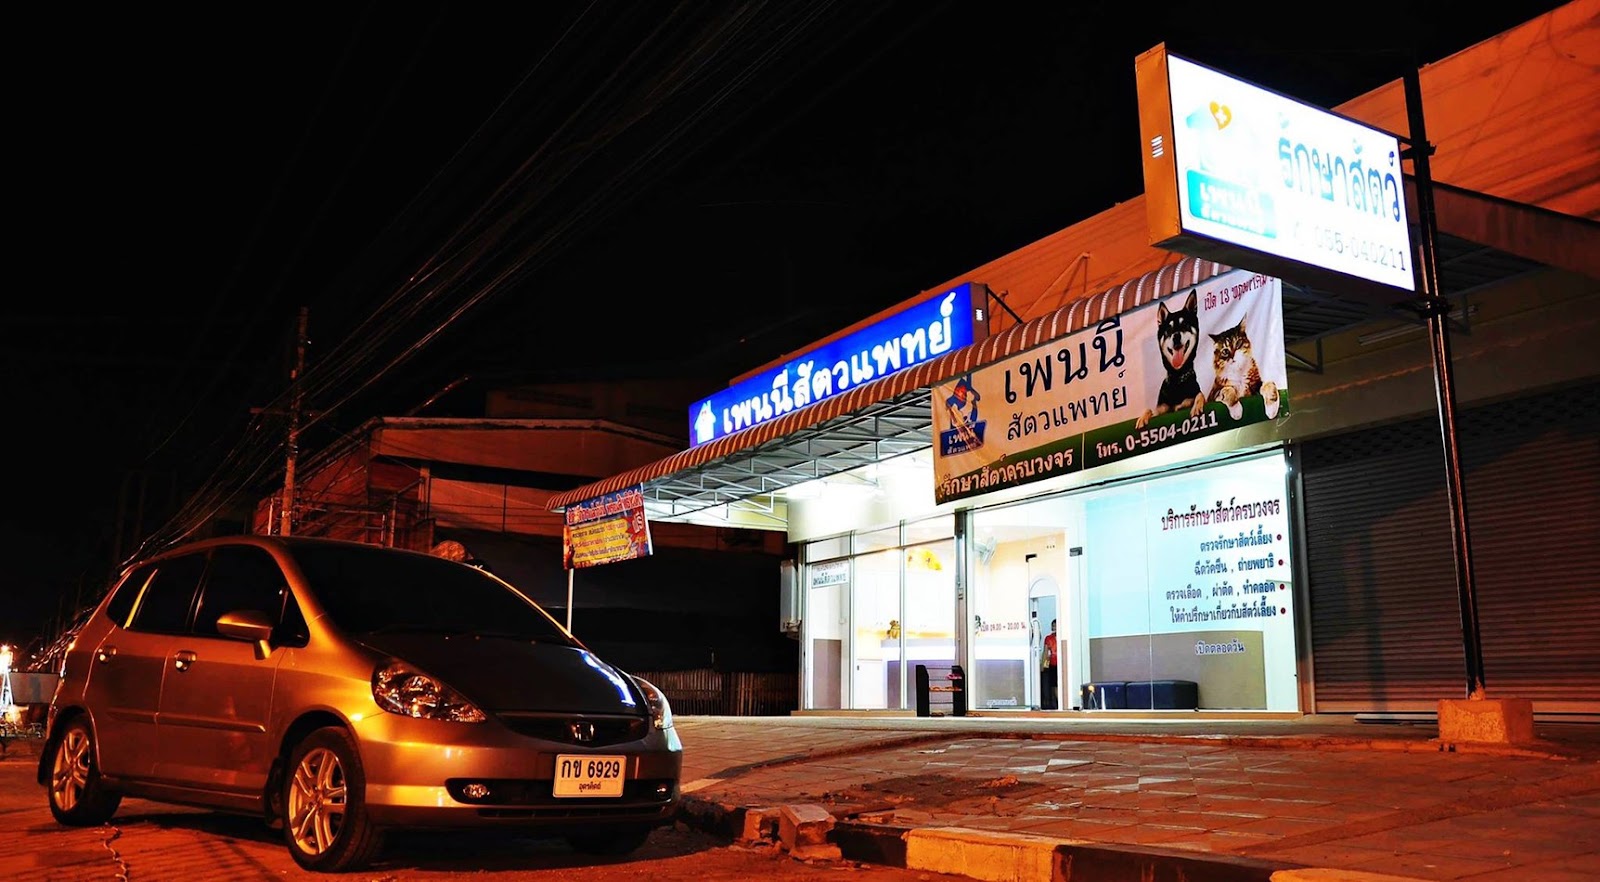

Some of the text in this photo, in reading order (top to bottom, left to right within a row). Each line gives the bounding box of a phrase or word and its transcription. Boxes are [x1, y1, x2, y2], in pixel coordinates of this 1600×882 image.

[1278, 112, 1400, 222] รักษาสัตว์
[1204, 292, 1217, 311] เปิด
[1220, 288, 1230, 305] 13
[723, 292, 956, 433] เพนนีสัตวแพทย์
[1005, 315, 1125, 404] เพนนี
[1007, 370, 1127, 441] สัตวแพทย์
[1096, 410, 1218, 459] โทร. 0-5504-0211
[942, 454, 1074, 496] รักษาสัตว์ครบวงจร
[1161, 497, 1280, 530] บริการรักษาสัตว์ครบวงจร
[1200, 524, 1273, 552] ตรวจรักษาสัตว์เลี้ยง
[1237, 552, 1275, 572] ถ่ายพยาธิ
[1166, 584, 1202, 600] ตรวจเลือด
[1212, 581, 1233, 597] ผ่าตัด
[1243, 579, 1276, 595] ทำคลอด
[1170, 595, 1277, 624] ให้คำปรึกษาเกี่ยวกับสัตว์เลี้ยง
[1195, 639, 1245, 655] เปิดตลอดวัน
[561, 760, 620, 778] กข 6929
